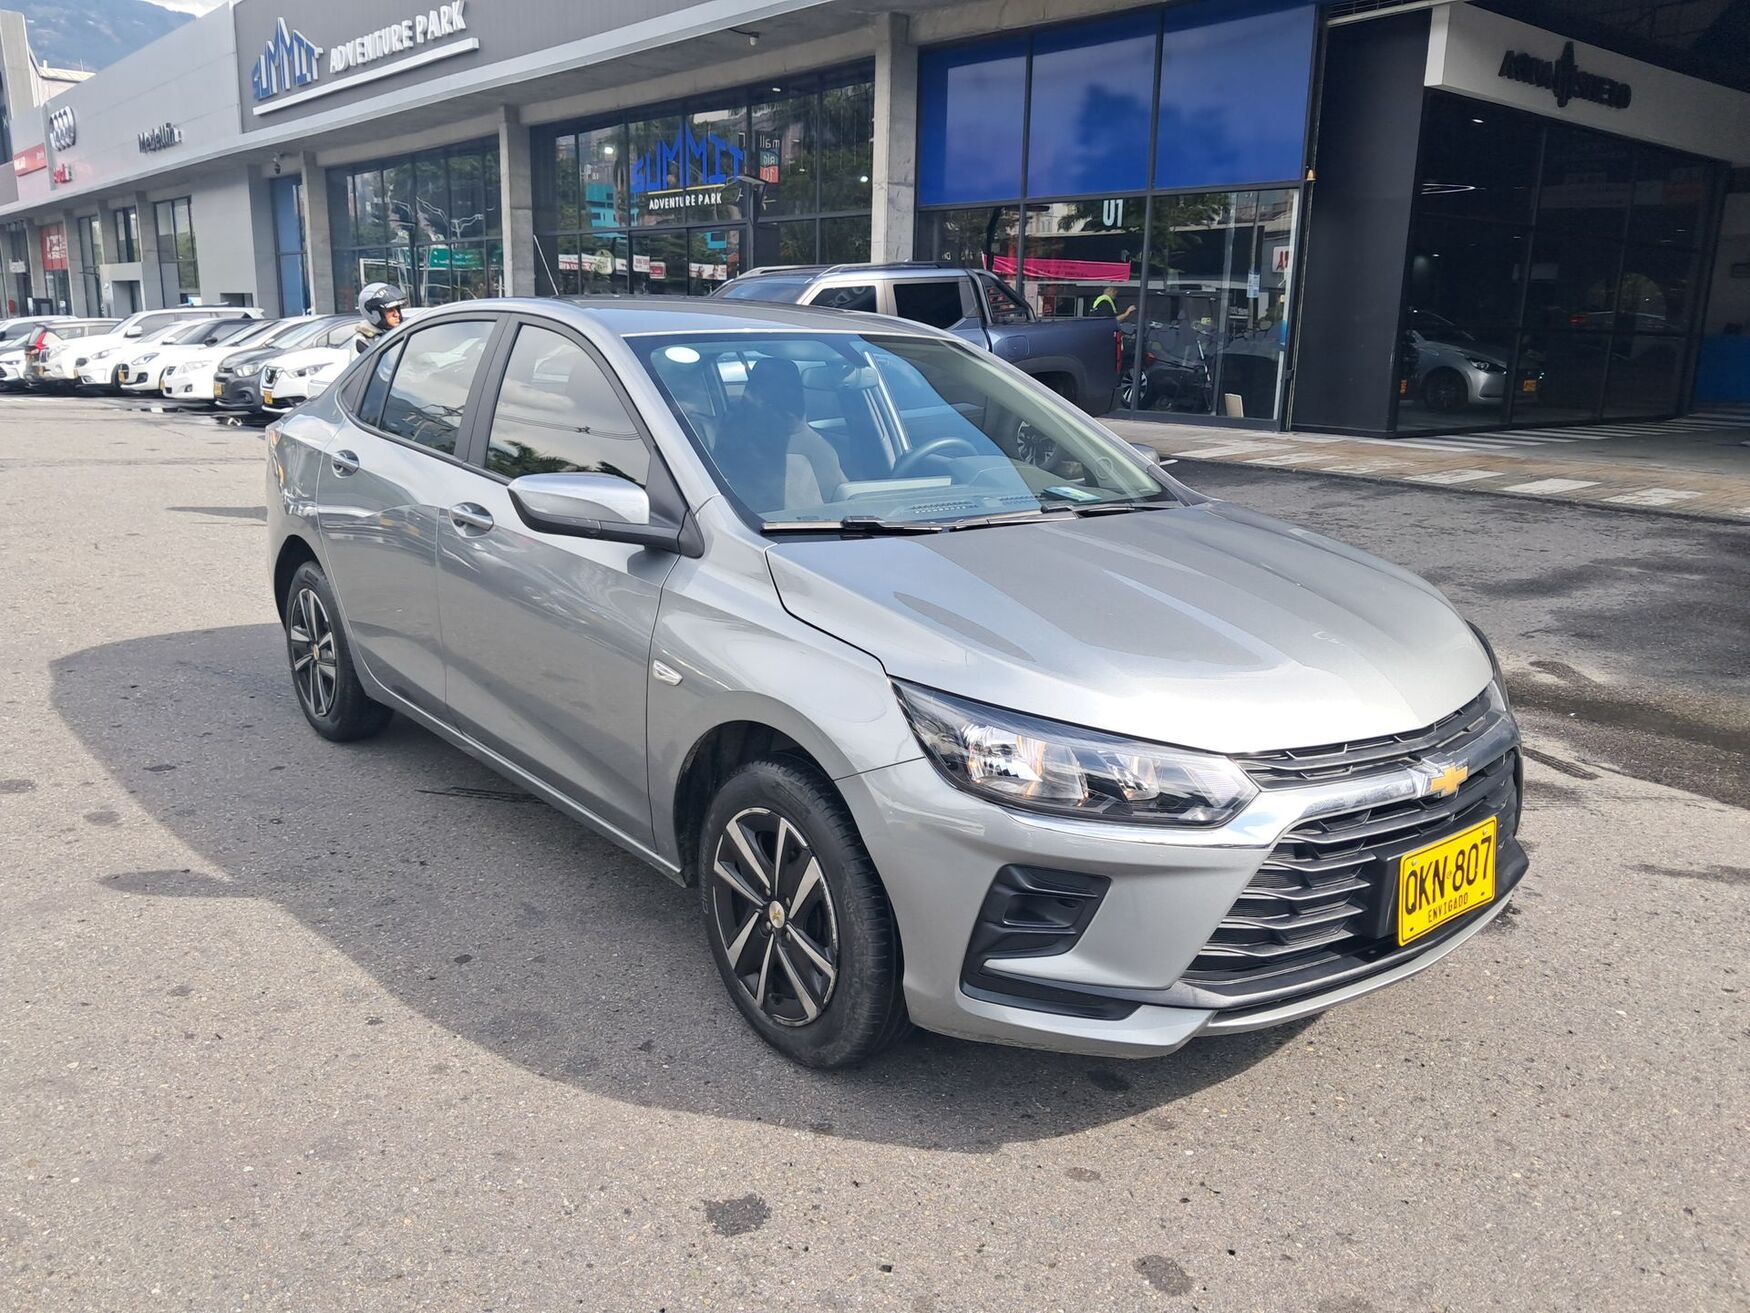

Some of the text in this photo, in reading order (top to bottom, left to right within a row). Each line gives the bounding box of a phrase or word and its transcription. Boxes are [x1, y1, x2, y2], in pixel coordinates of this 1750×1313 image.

[329, 0, 467, 74] ADVENTURE PARK
[649, 192, 722, 210] ADVENTURE PARK
[1427, 892, 1469, 923] ENVIGADO
